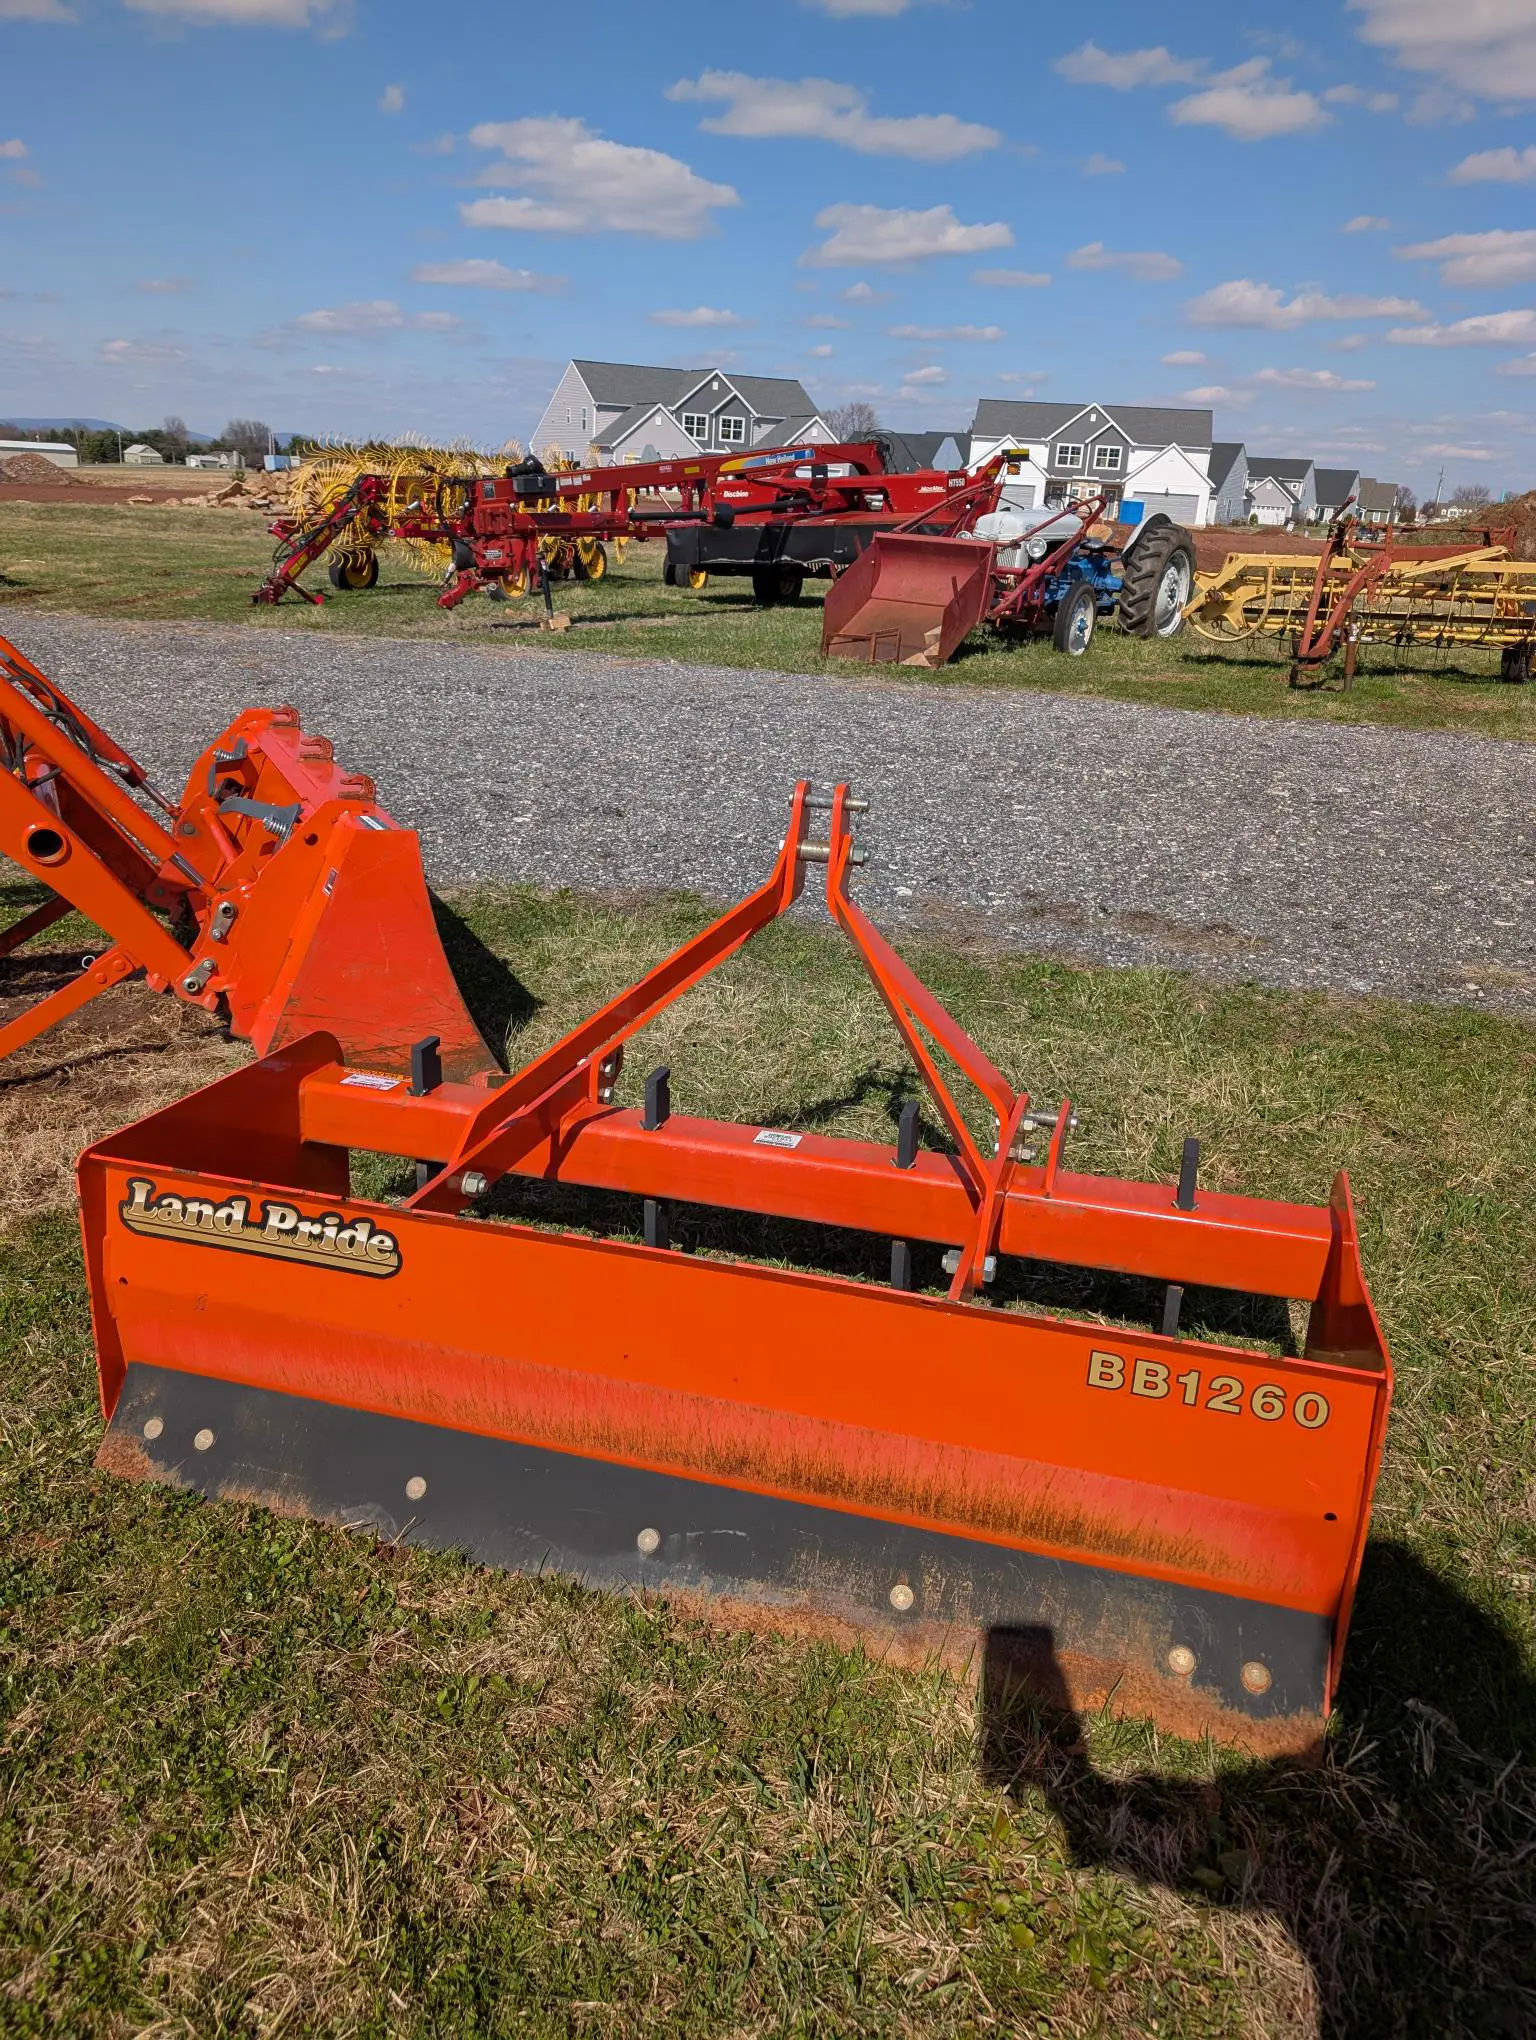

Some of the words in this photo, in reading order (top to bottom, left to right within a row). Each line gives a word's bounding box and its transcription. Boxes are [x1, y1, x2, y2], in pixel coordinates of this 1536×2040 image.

[765, 457, 776, 465] New
[777, 453, 795, 464] Holland
[723, 490, 749, 498] Discbine
[128, 1180, 247, 1235] Land
[261, 1205, 395, 1261] Pride
[1087, 1350, 1330, 1429] BB1260
